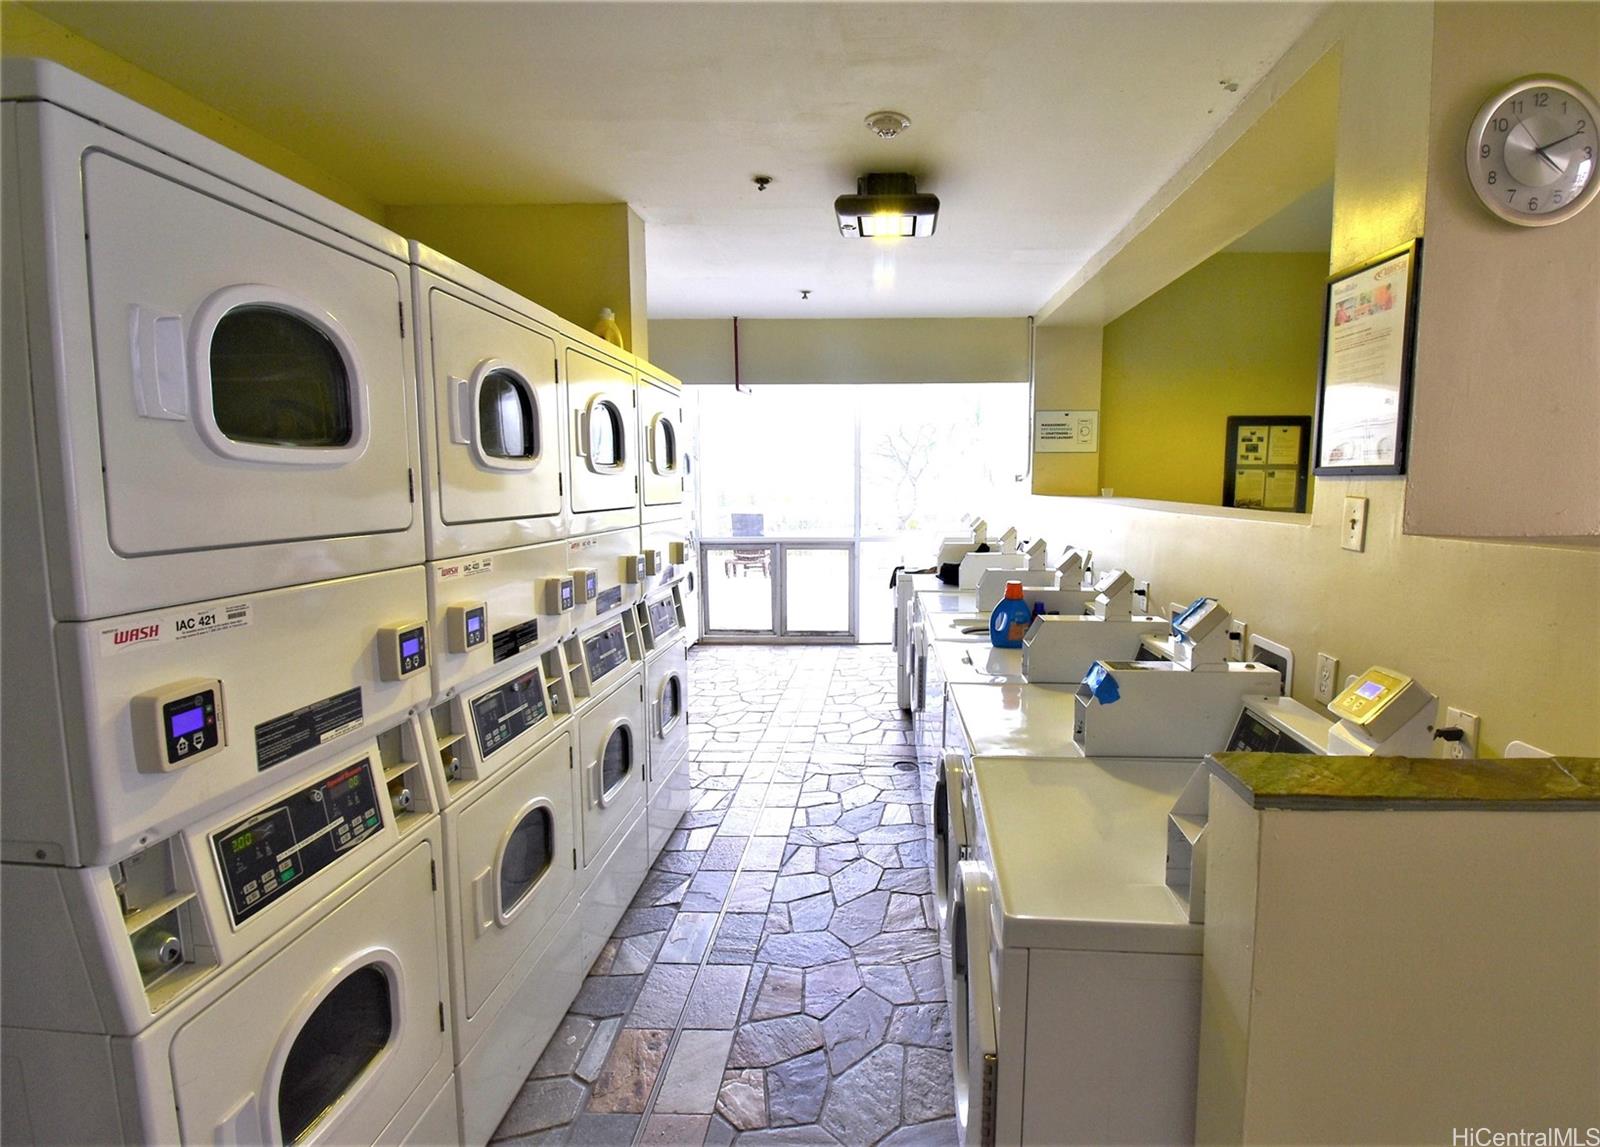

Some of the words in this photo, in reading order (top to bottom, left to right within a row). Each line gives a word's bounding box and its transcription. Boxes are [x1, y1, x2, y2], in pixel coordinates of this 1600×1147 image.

[1533, 93, 1549, 107] 12
[1511, 101, 1523, 114] 11
[1561, 102, 1568, 114] 1
[1492, 118, 1509, 132] 10
[1576, 120, 1585, 134] 2
[1481, 144, 1491, 158] 9
[1583, 146, 1593, 160] 3
[1488, 170, 1497, 185] 8
[1506, 189, 1517, 203] 7
[1553, 190, 1562, 204] 5
[1528, 197, 1538, 211] 6
[114, 624, 160, 645] WASH
[176, 618, 196, 632] IAC
[198, 614, 216, 627] 421
